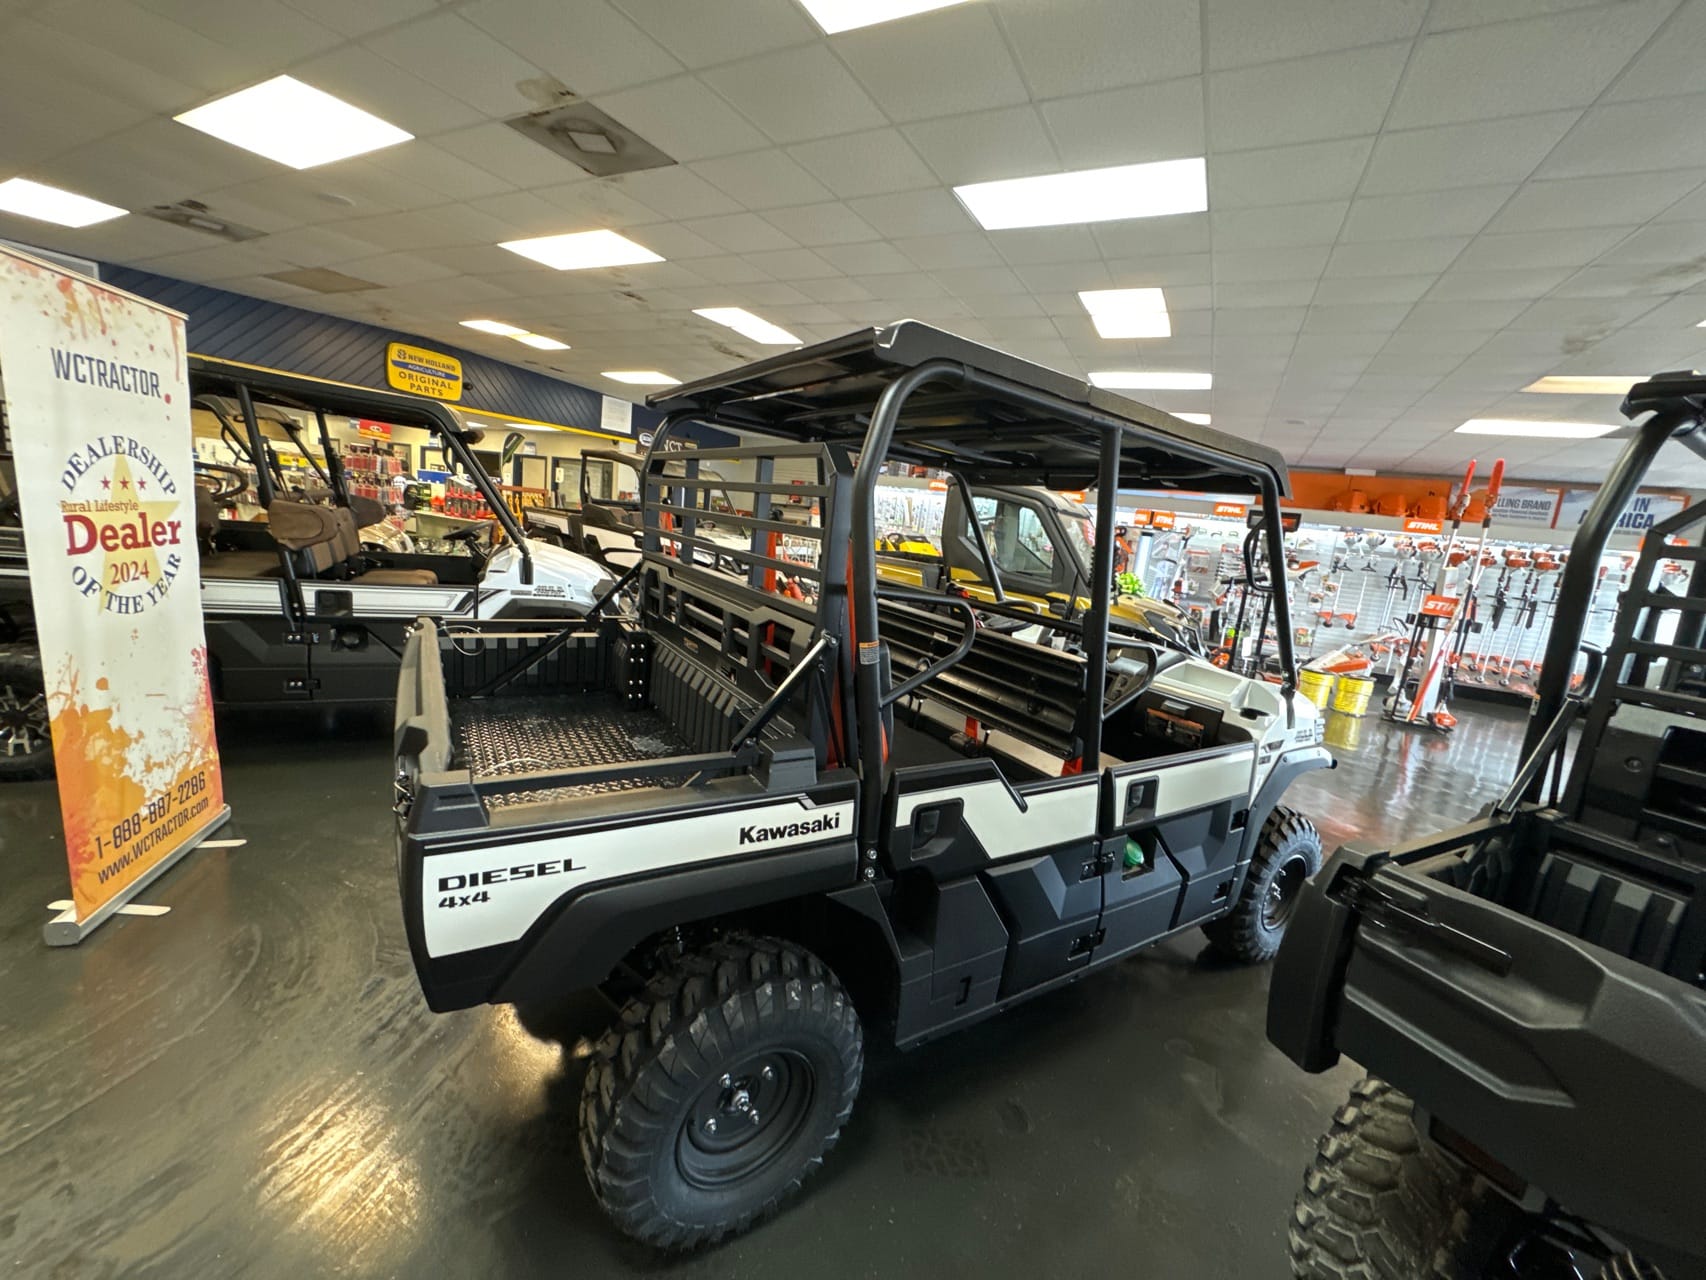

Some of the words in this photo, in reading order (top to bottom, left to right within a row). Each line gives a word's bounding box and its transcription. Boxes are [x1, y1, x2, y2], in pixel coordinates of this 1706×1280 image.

[407, 363, 447, 378] AGRICULTURE
[408, 354, 425, 364] NEW
[425, 357, 456, 372] HOLLAND
[50, 347, 162, 399] WCTRACTOR
[398, 371, 454, 390] ORIGINAL
[409, 383, 444, 397] PARTS
[61, 434, 177, 495] DEALERSHIP
[60, 499, 92, 513] Rural
[95, 499, 139, 515] Lifestyle
[1215, 505, 1243, 515] STIHL
[1497, 497, 1521, 509] LLING
[1521, 499, 1553, 511] BRAND
[1633, 497, 1652, 513] IN
[63, 511, 181, 556] Dealer
[1407, 521, 1440, 531] STIHL
[110, 559, 150, 585] 2024
[72, 565, 103, 598] OF
[105, 590, 145, 614] THE
[146, 553, 182, 607] YEAR
[95, 771, 206, 860] 1-888-887-2286
[738, 811, 840, 846] Kawasaki
[438, 858, 587, 893] DIESEL
[438, 890, 491, 909] 4x4
